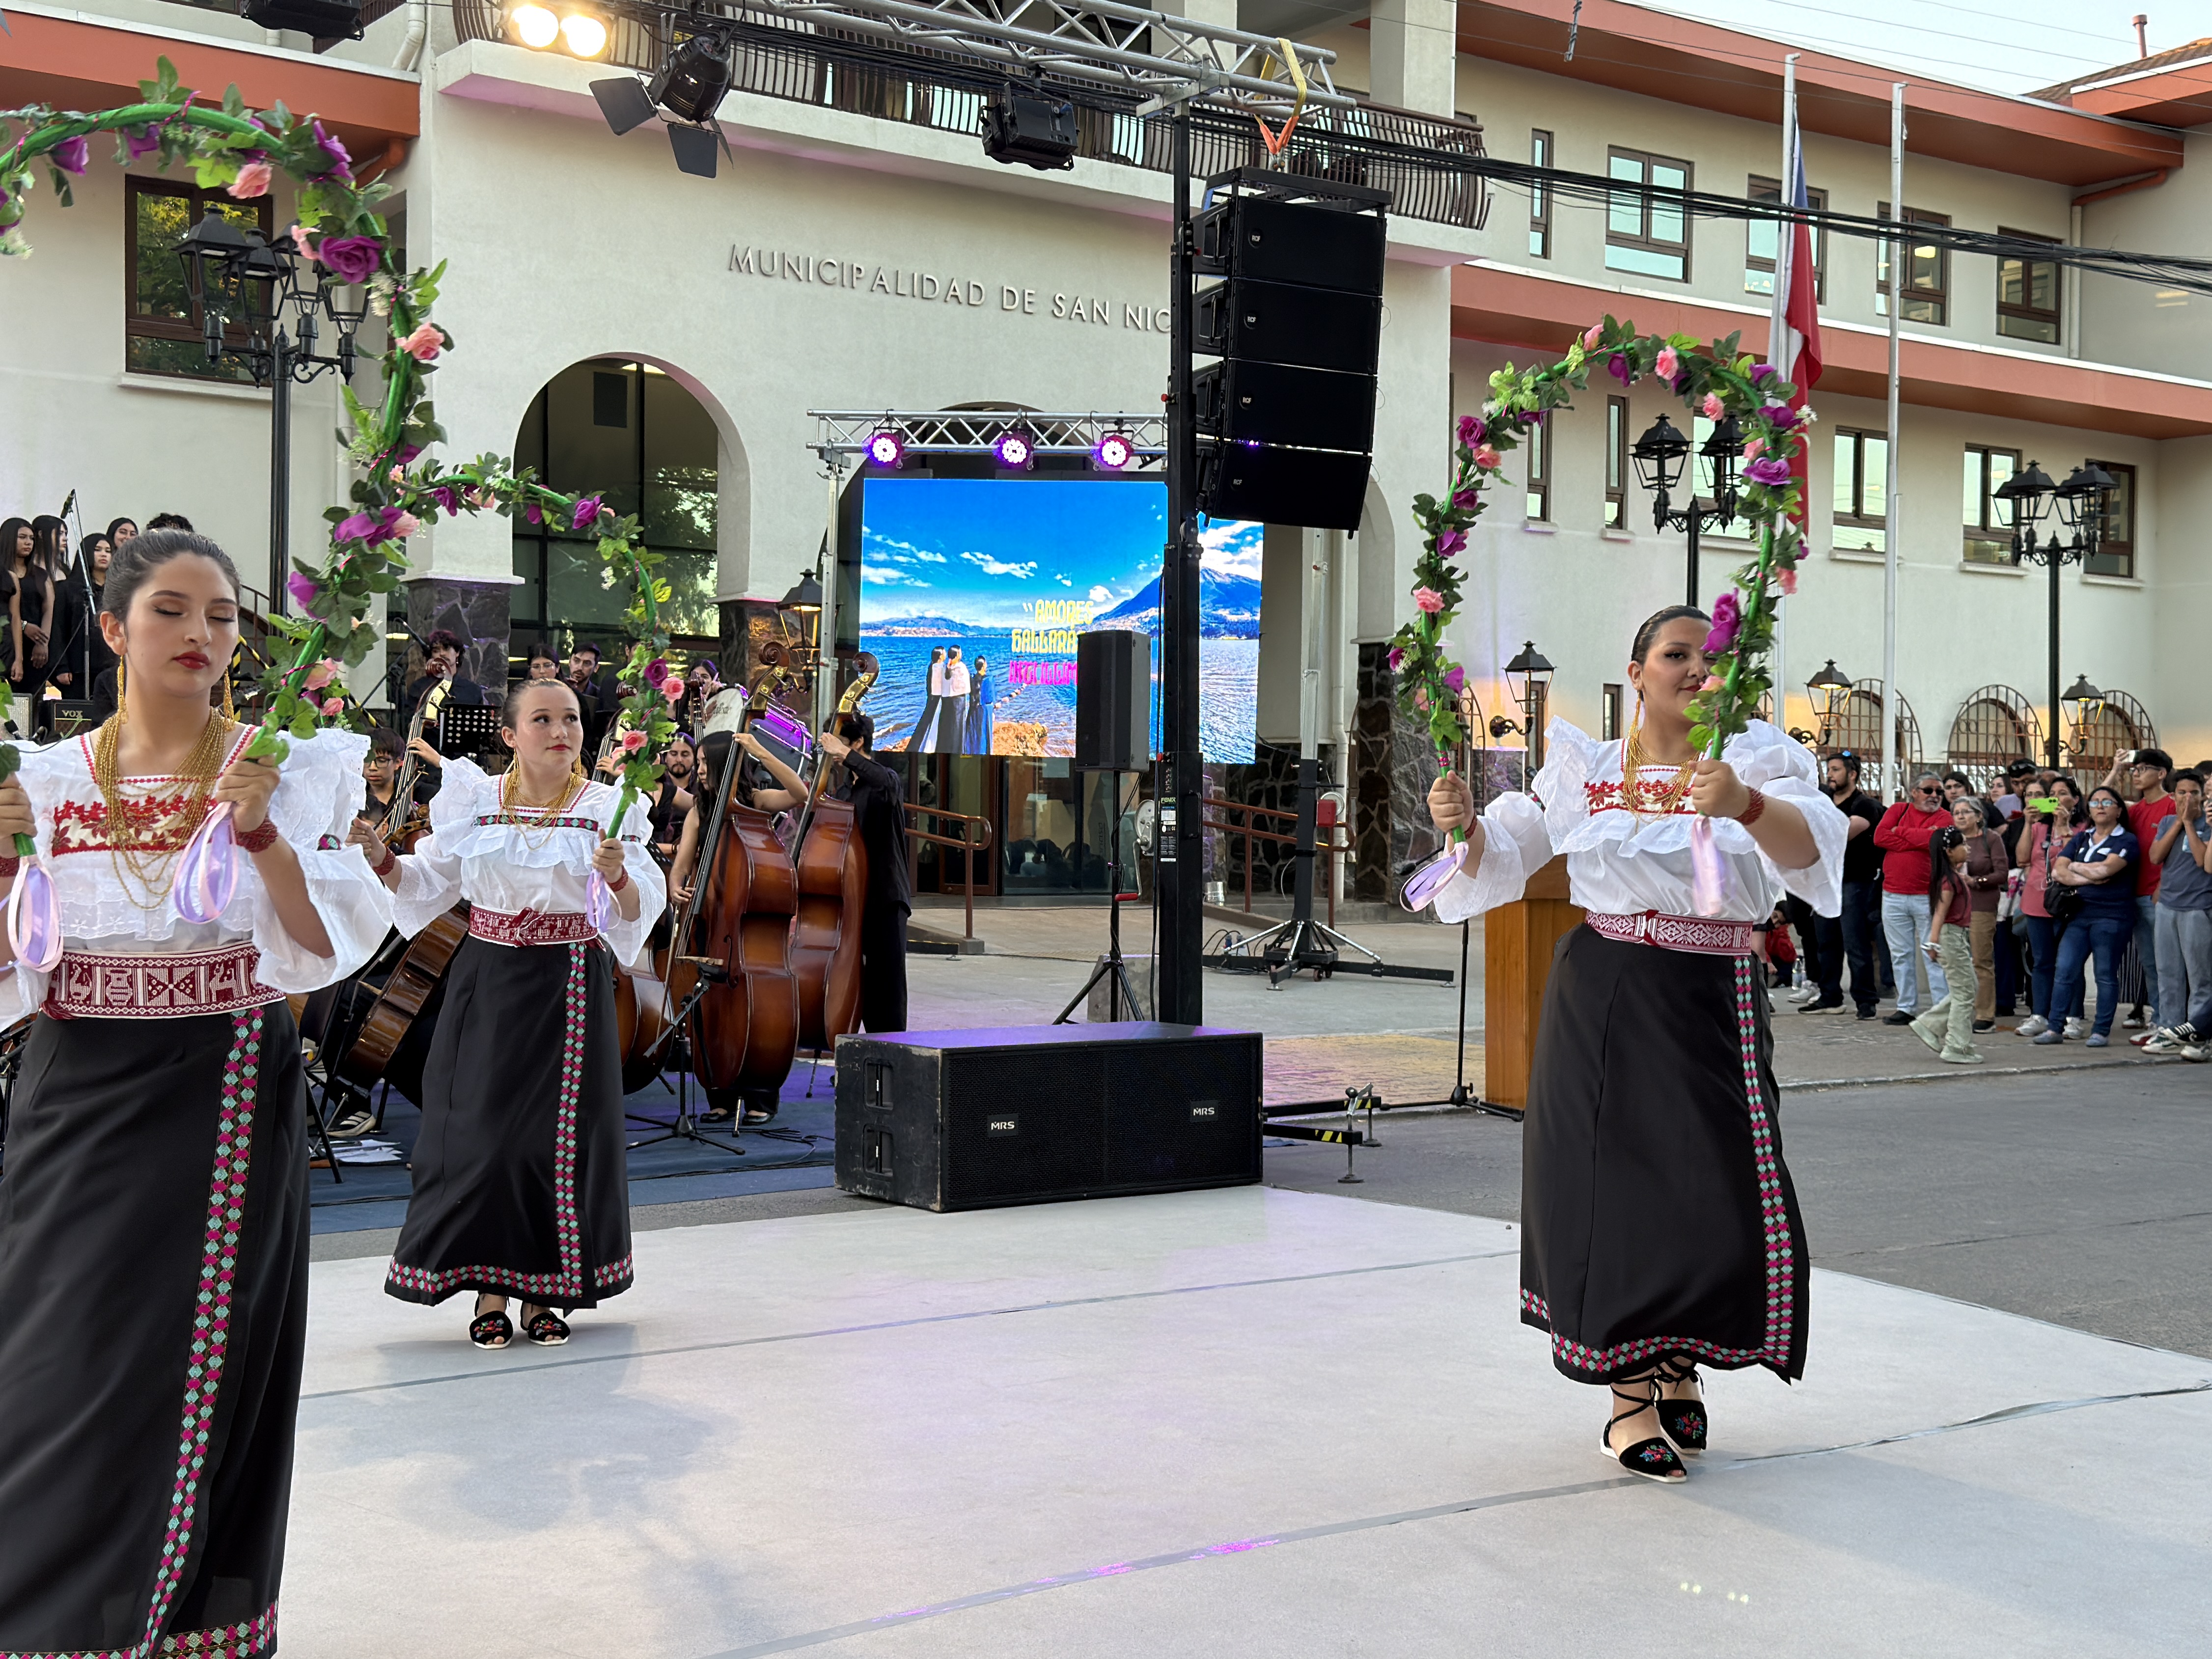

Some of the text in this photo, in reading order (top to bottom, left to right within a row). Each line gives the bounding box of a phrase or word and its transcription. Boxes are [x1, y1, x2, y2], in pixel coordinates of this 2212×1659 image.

[728, 244, 985, 305] MUNICIPALIDAD
[1002, 285, 1035, 313] DE
[1052, 293, 1110, 325] SAN
[1193, 1107, 1215, 1116] MRS
[991, 1121, 1015, 1130] MRS
